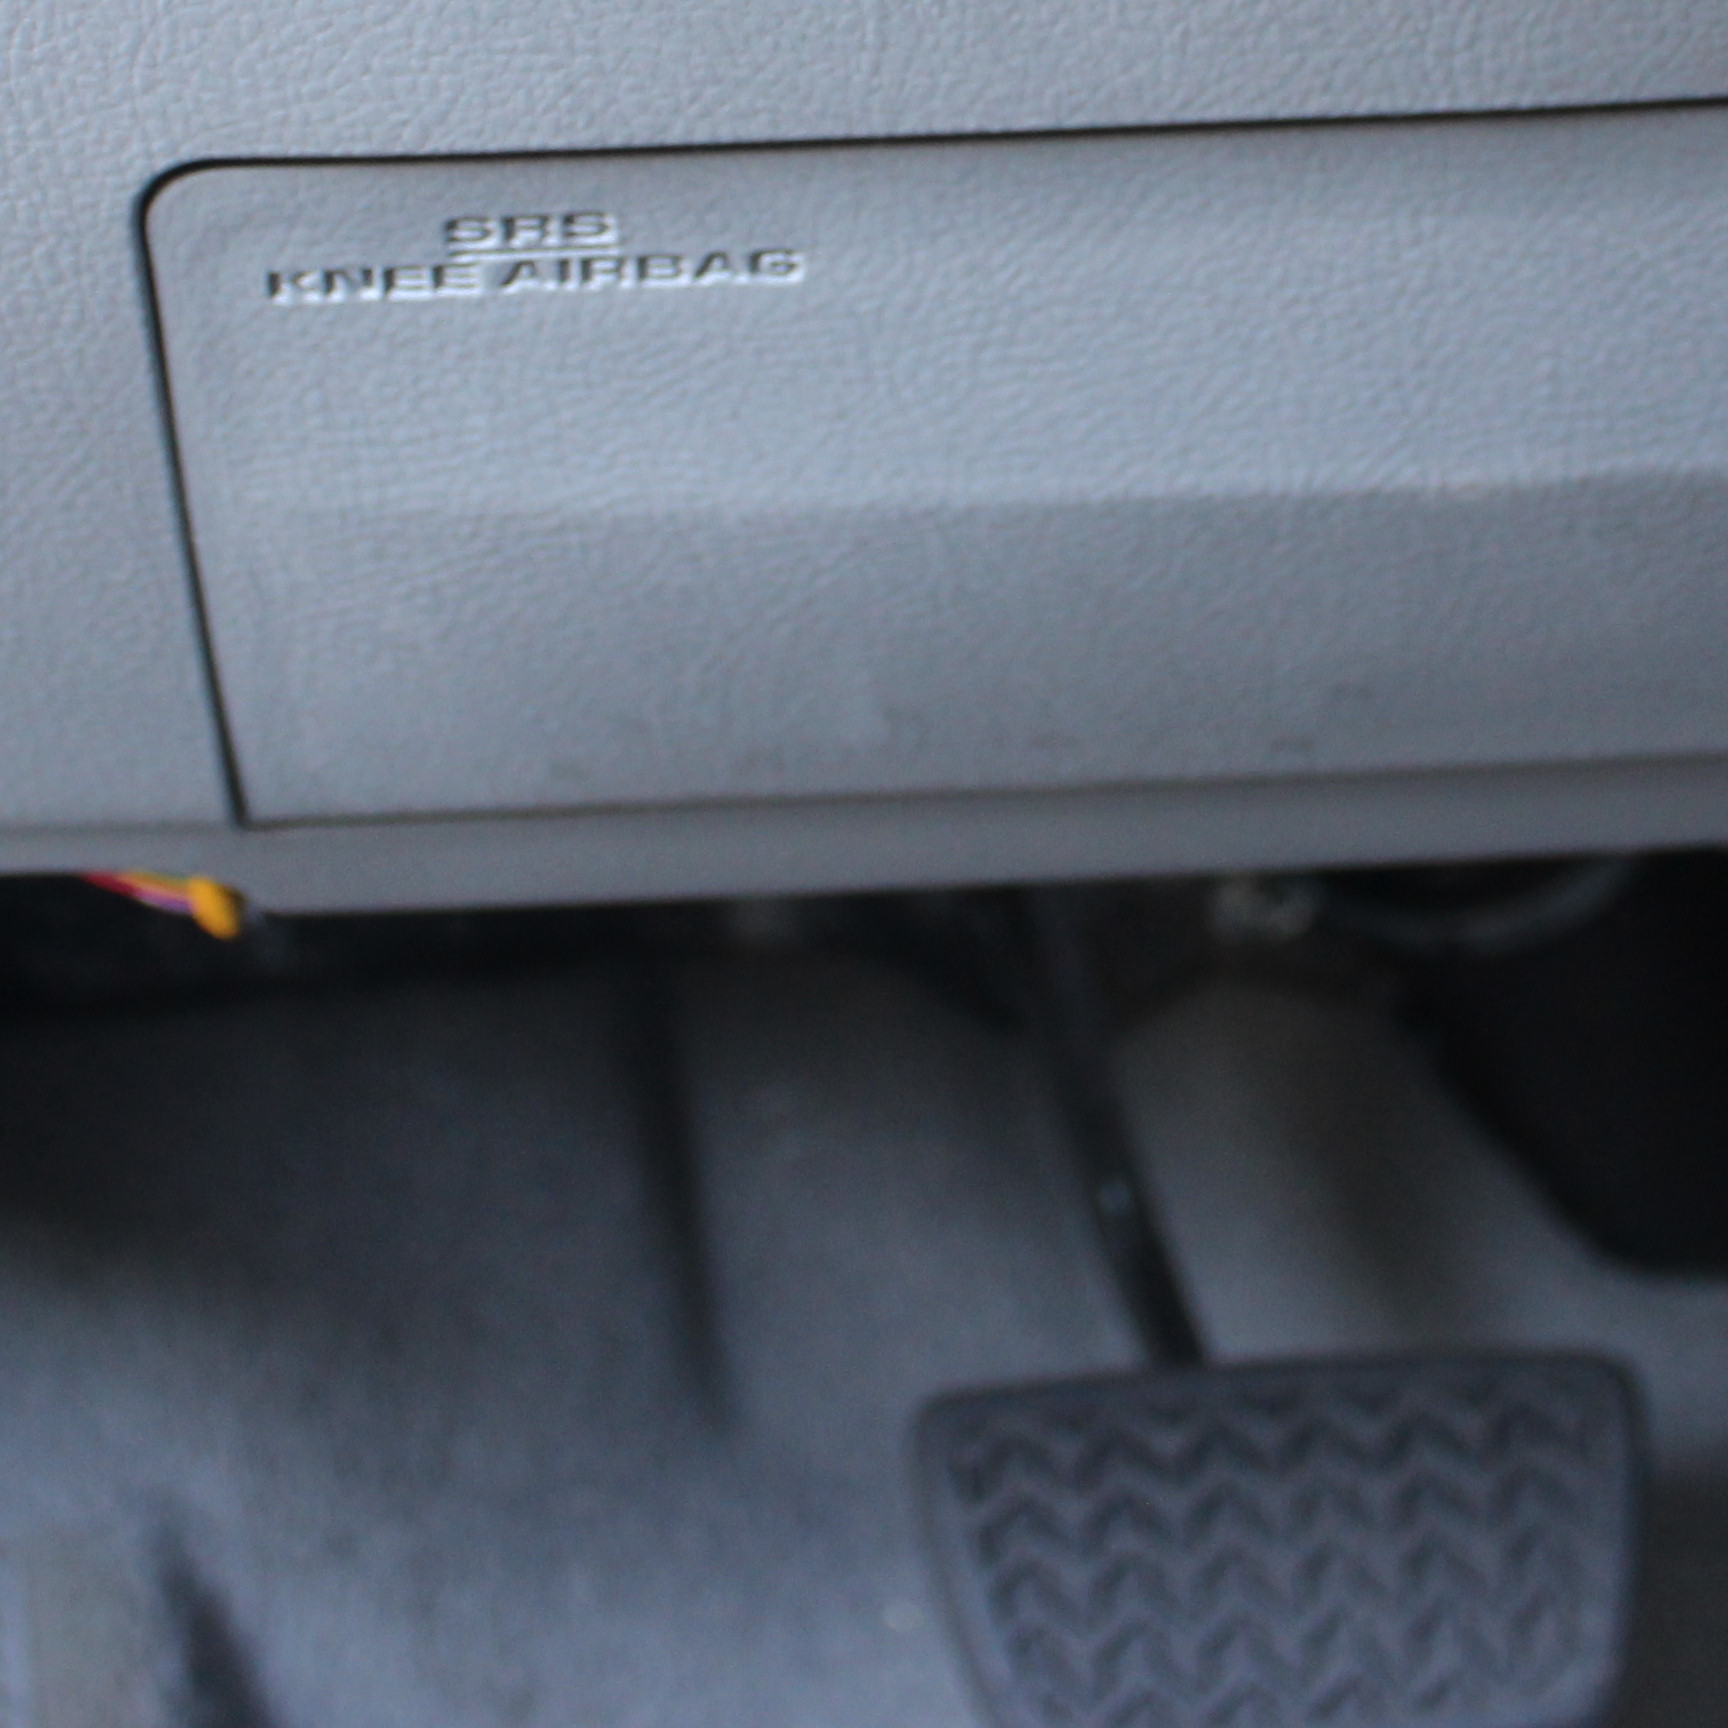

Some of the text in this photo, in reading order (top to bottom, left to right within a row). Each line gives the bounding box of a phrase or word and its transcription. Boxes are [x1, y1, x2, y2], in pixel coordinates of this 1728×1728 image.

[442, 210, 618, 247] SRS
[267, 248, 805, 305] KNEE AIRBAG
